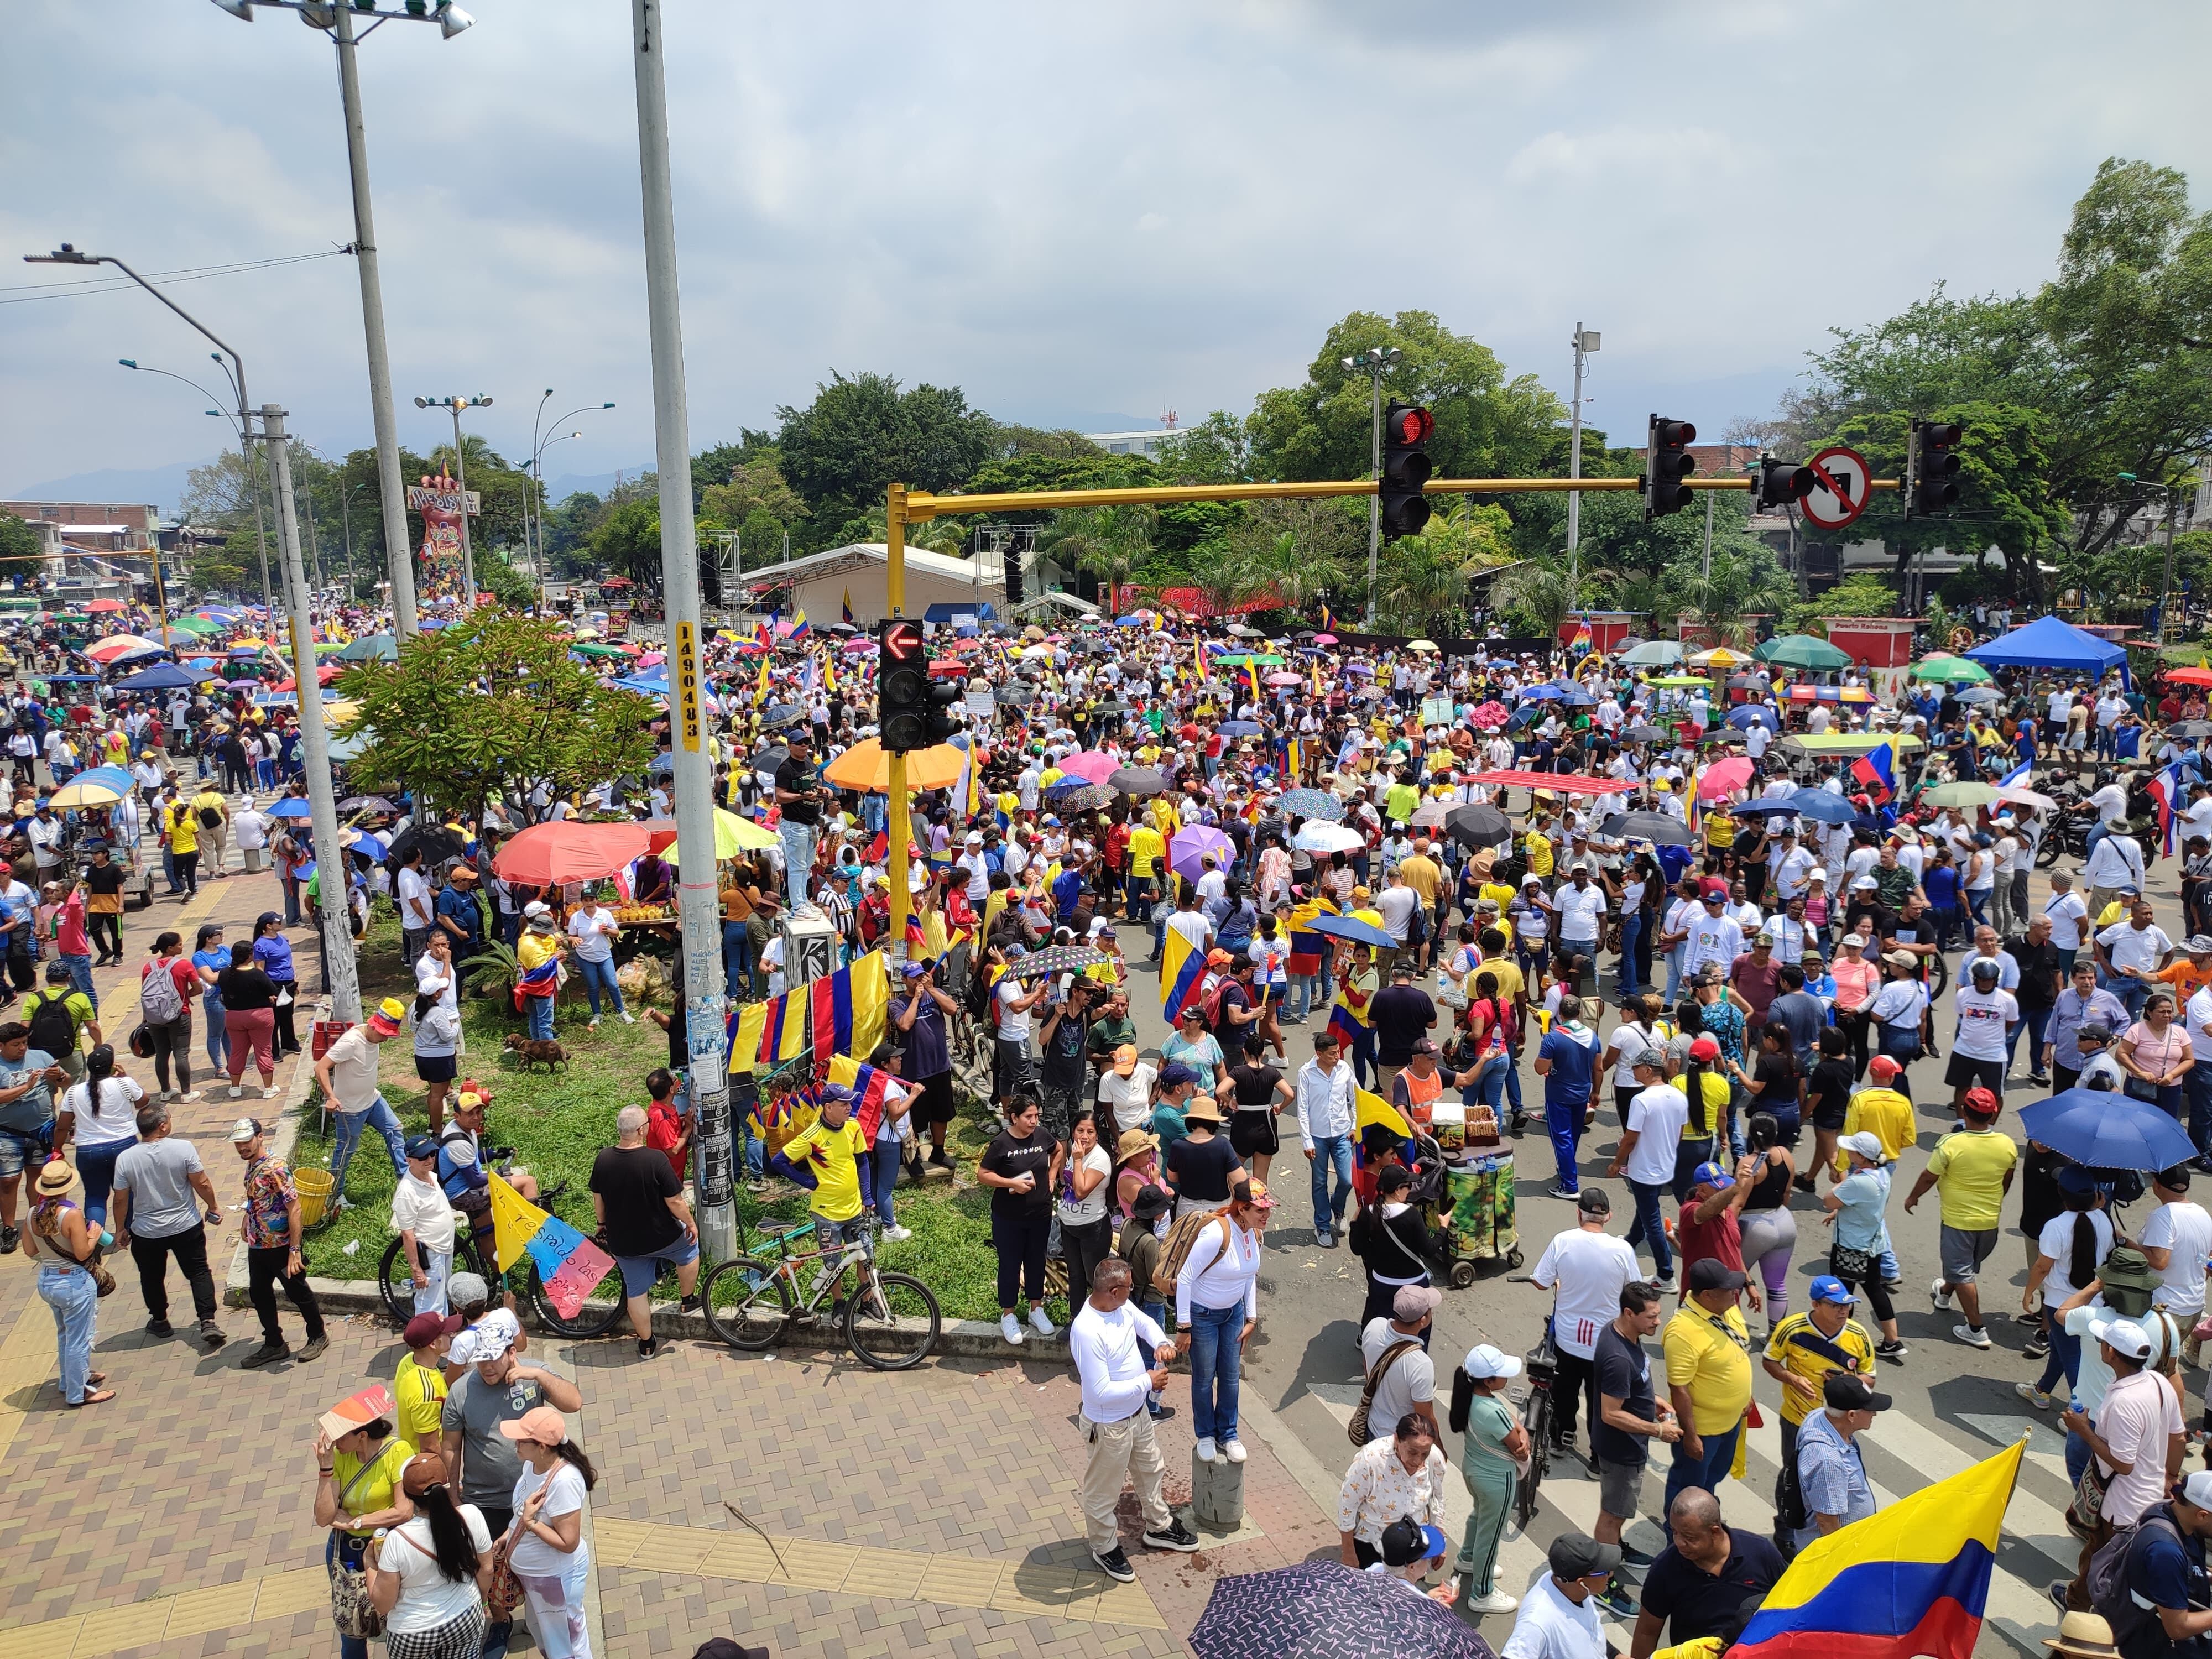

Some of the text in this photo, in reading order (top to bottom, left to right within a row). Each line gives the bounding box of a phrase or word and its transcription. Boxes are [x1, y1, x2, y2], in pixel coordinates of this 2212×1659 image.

[681, 626, 697, 737] 1490483
[320, 838, 336, 908] METALTEC
[1966, 1007, 2000, 1020] PACTO
[515, 1213, 576, 1265] respaldo
[578, 1259, 598, 1282] las
[821, 1265, 844, 1294] TREK
